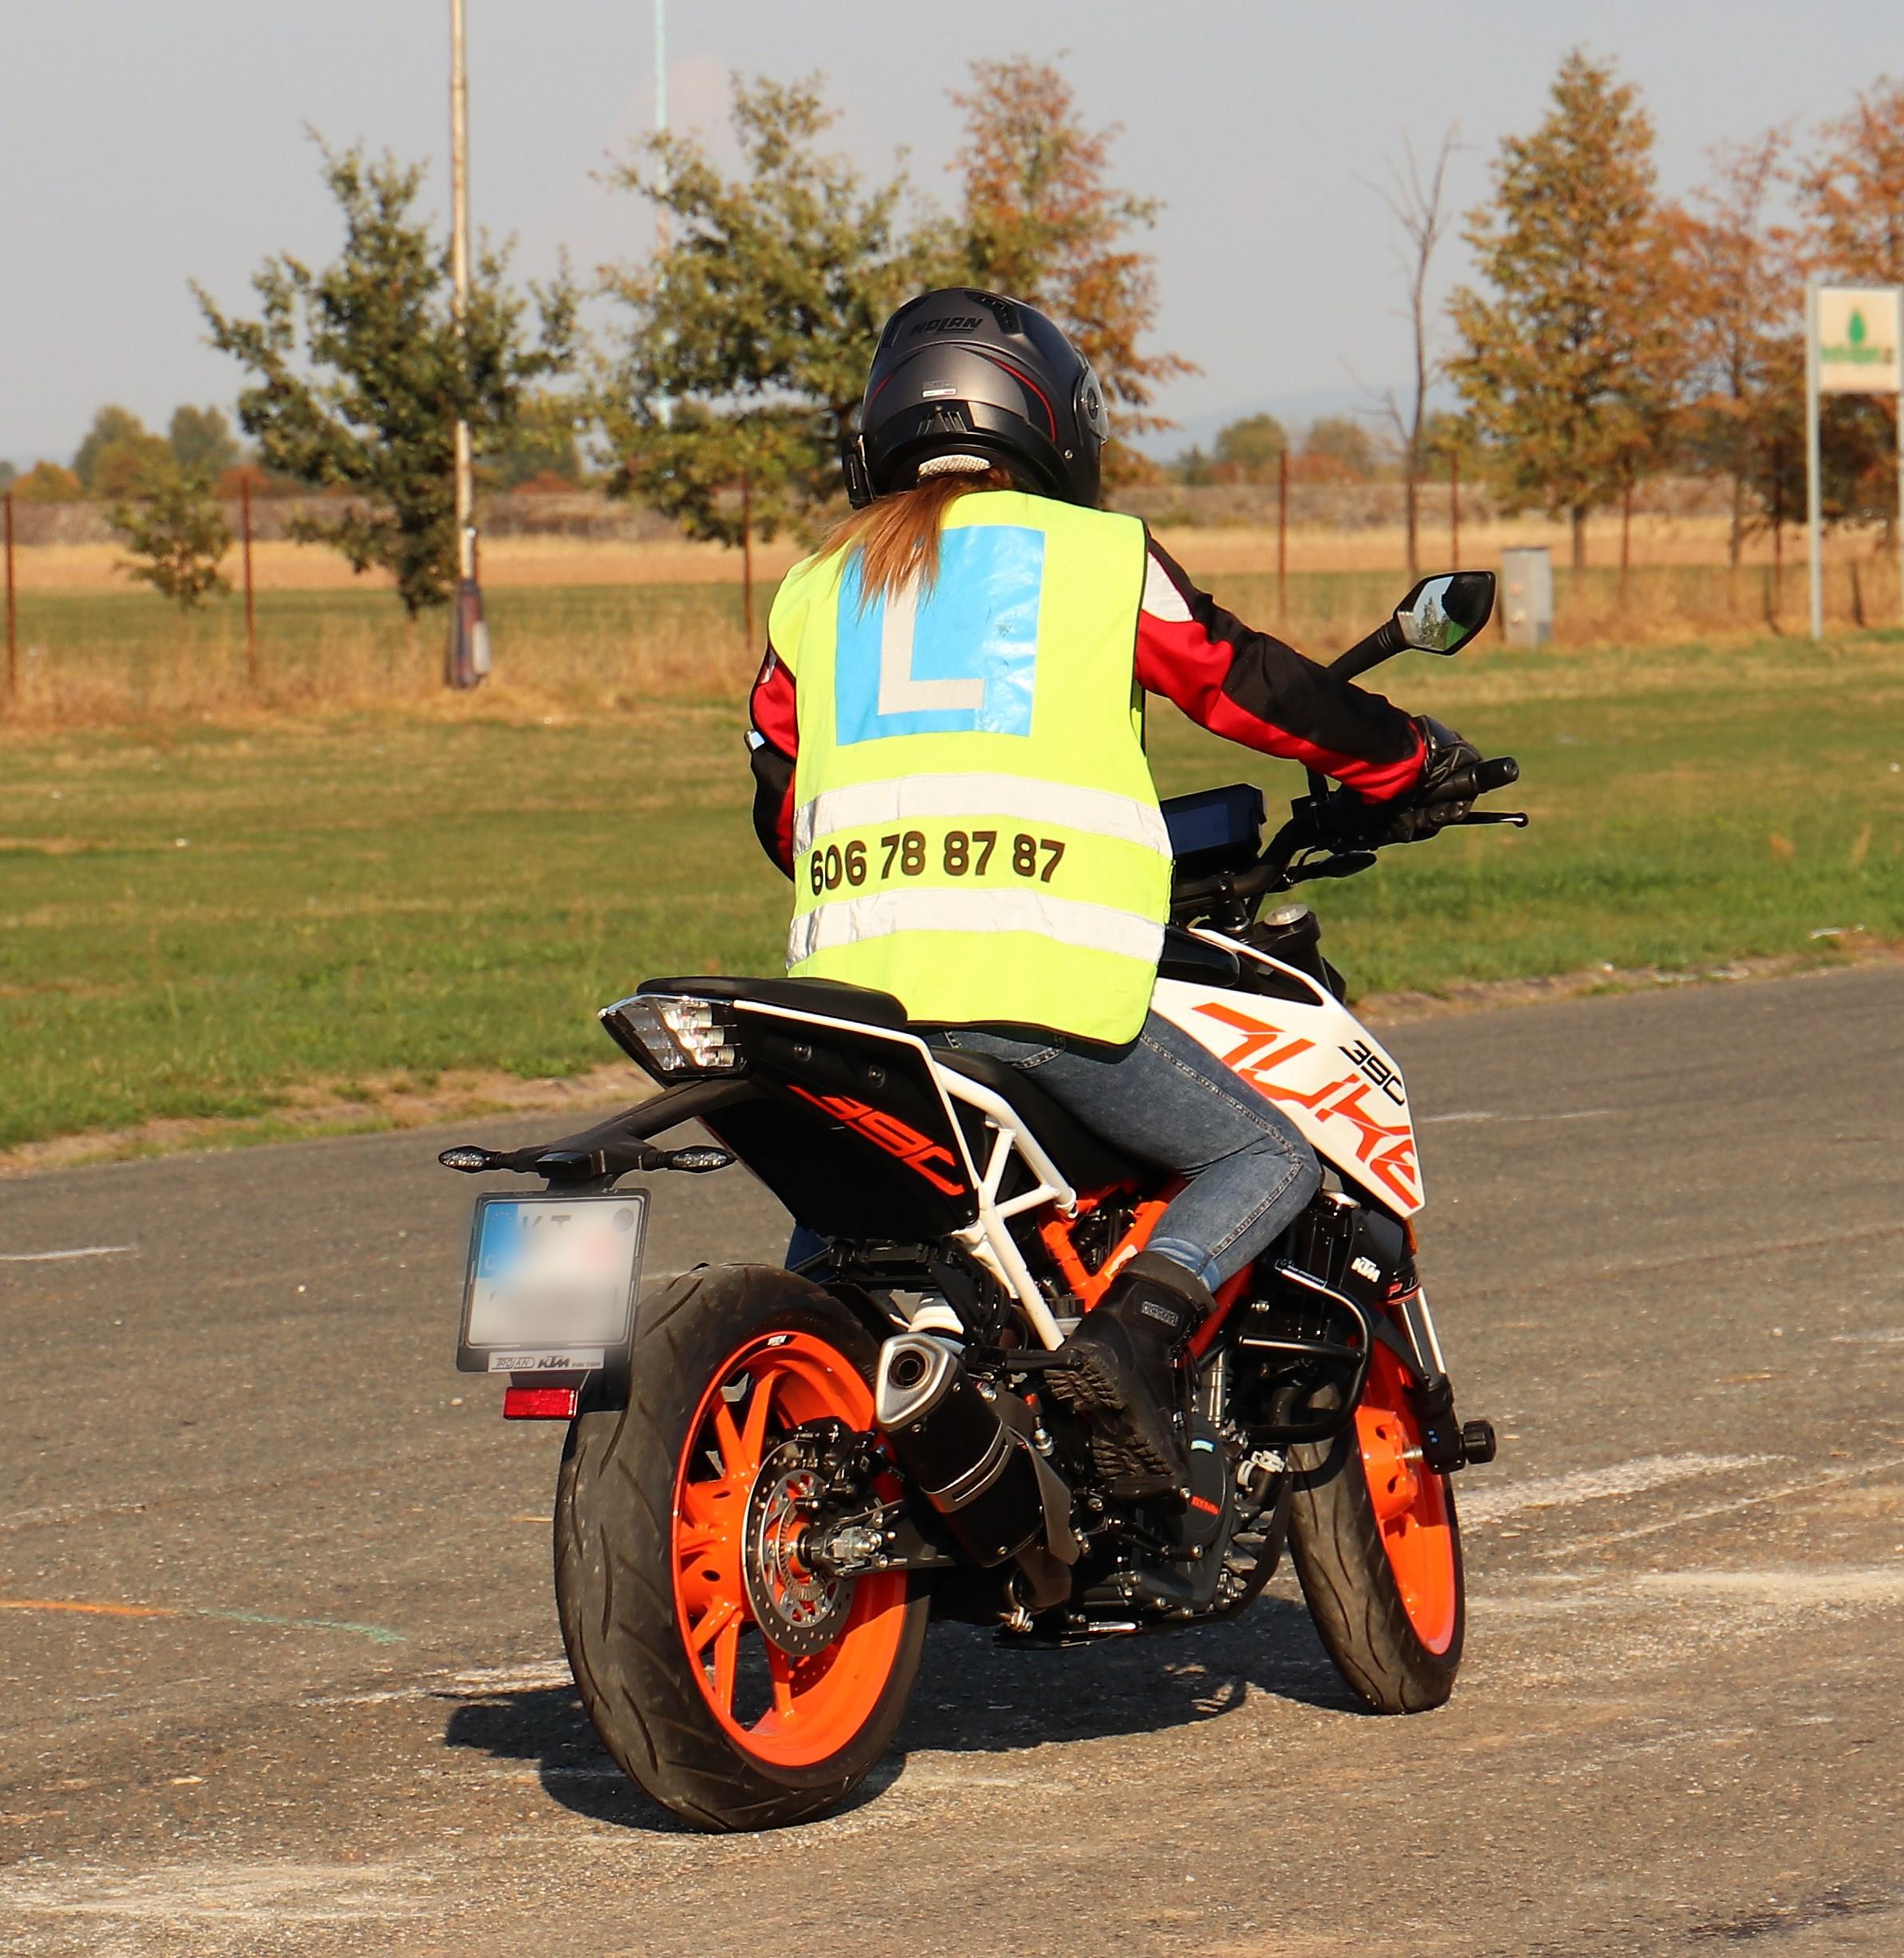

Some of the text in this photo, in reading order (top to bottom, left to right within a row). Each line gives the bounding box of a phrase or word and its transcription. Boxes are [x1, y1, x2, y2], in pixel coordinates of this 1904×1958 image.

[910, 318, 983, 336] NOLAN
[878, 560, 986, 716] L
[810, 831, 1065, 896] 606 78 87 87
[538, 1356, 570, 1368] KTM
